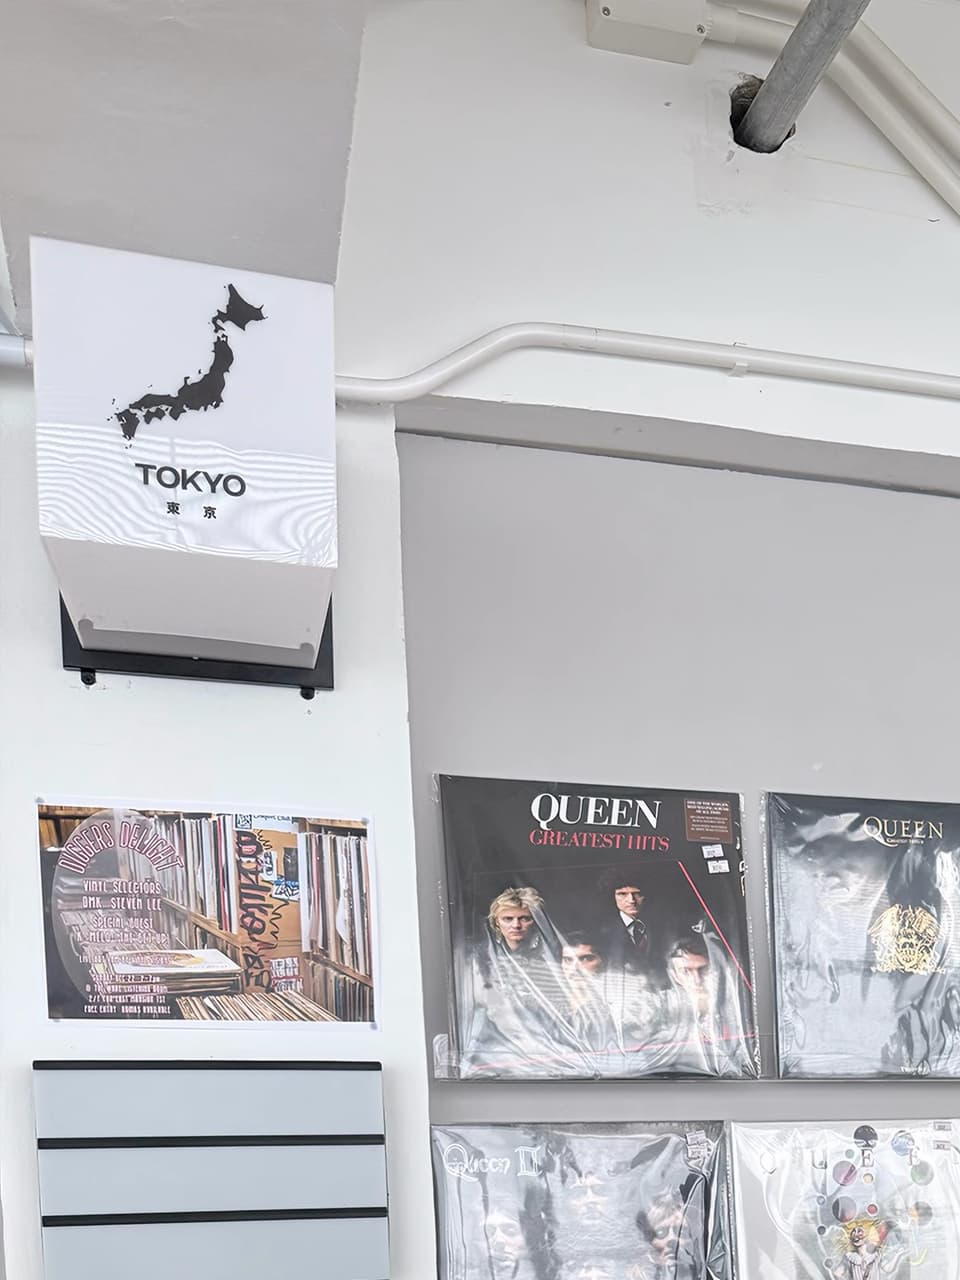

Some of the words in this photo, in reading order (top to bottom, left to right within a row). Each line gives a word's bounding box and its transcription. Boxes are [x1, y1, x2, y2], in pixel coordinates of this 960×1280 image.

[135, 462, 247, 498] TOKYO
[529, 792, 662, 830] QUEEN
[59, 822, 115, 874] DIGGERS
[120, 821, 184, 872] DELIGHT
[528, 828, 621, 851] GREATEST
[625, 833, 670, 853] HITS
[863, 816, 944, 847] QUEEN
[83, 880, 107, 892] VINYL
[113, 881, 161, 894] SELECTORS
[111, 897, 143, 910] STEVEN
[147, 898, 161, 910] LEE
[444, 1143, 511, 1182] Queen
